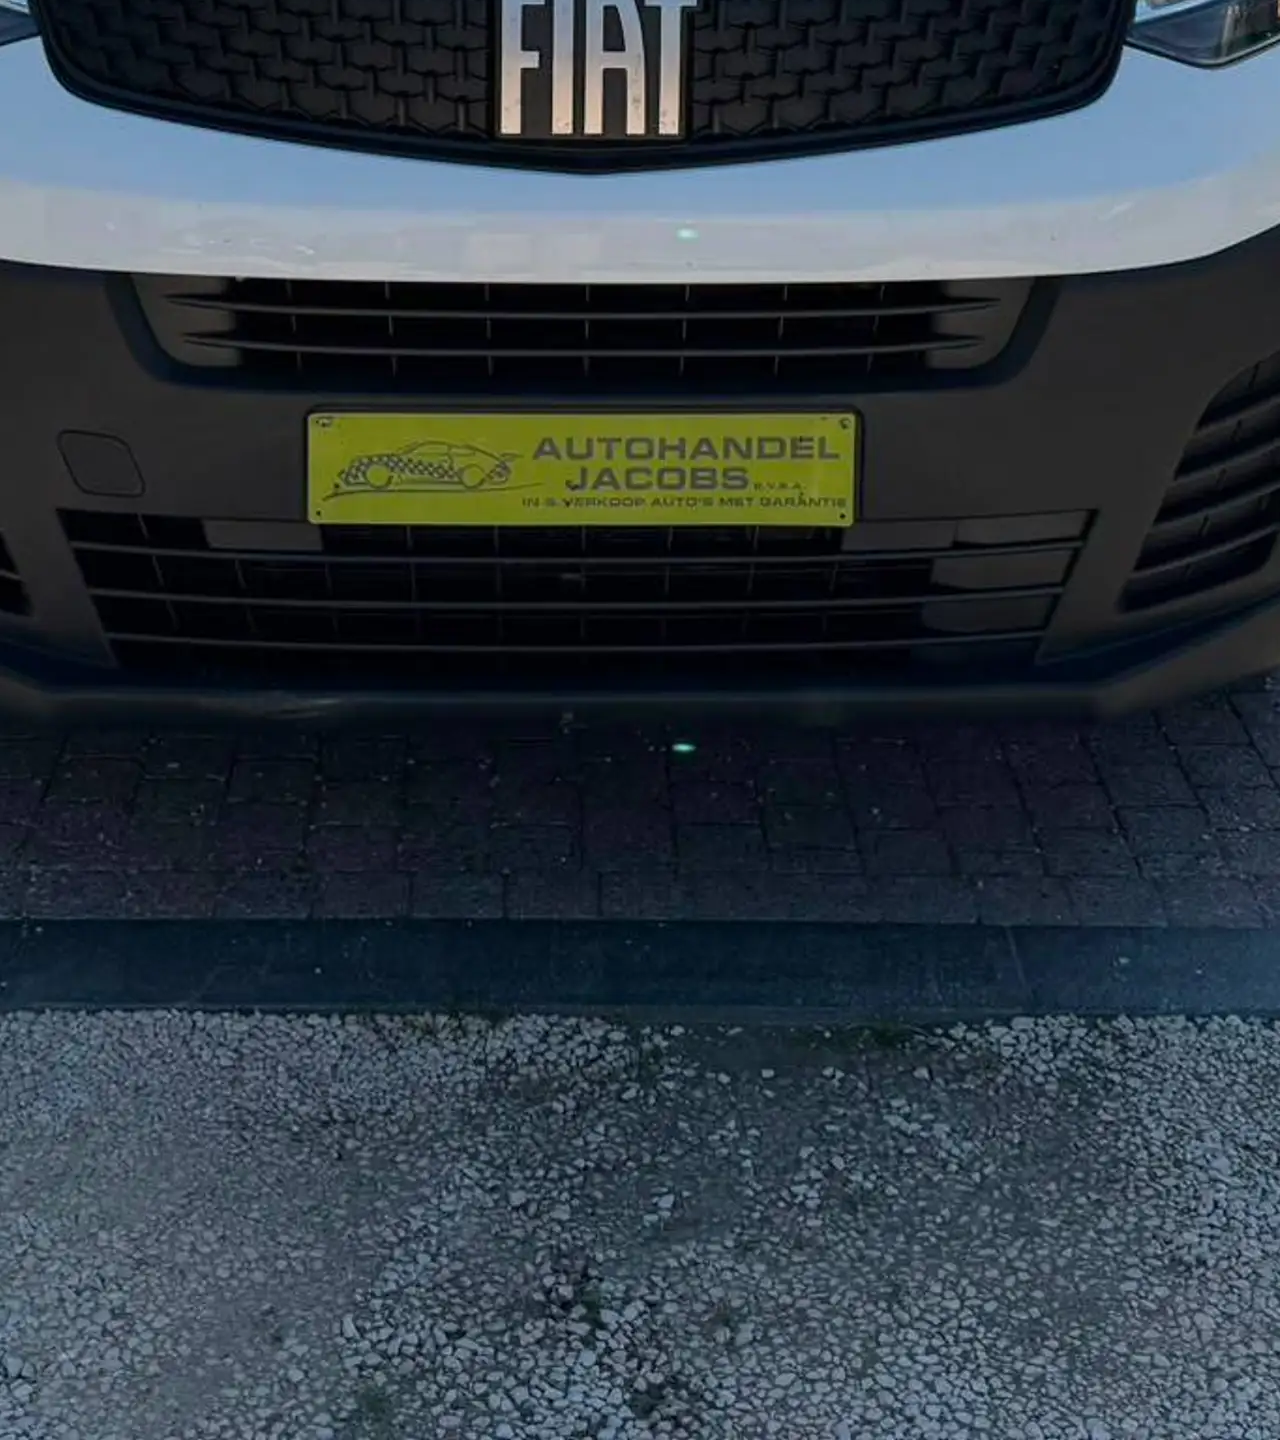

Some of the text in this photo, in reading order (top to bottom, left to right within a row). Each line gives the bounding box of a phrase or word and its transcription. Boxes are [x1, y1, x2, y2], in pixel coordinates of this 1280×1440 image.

[533, 436, 840, 460] AUTOHANDEL
[565, 466, 750, 491] JACOBS
[522, 497, 540, 507] IN
[562, 497, 645, 507] VERKOOP
[651, 497, 714, 507] AUTO'S
[720, 497, 753, 507] MET
[760, 496, 847, 507] GARANTIE
